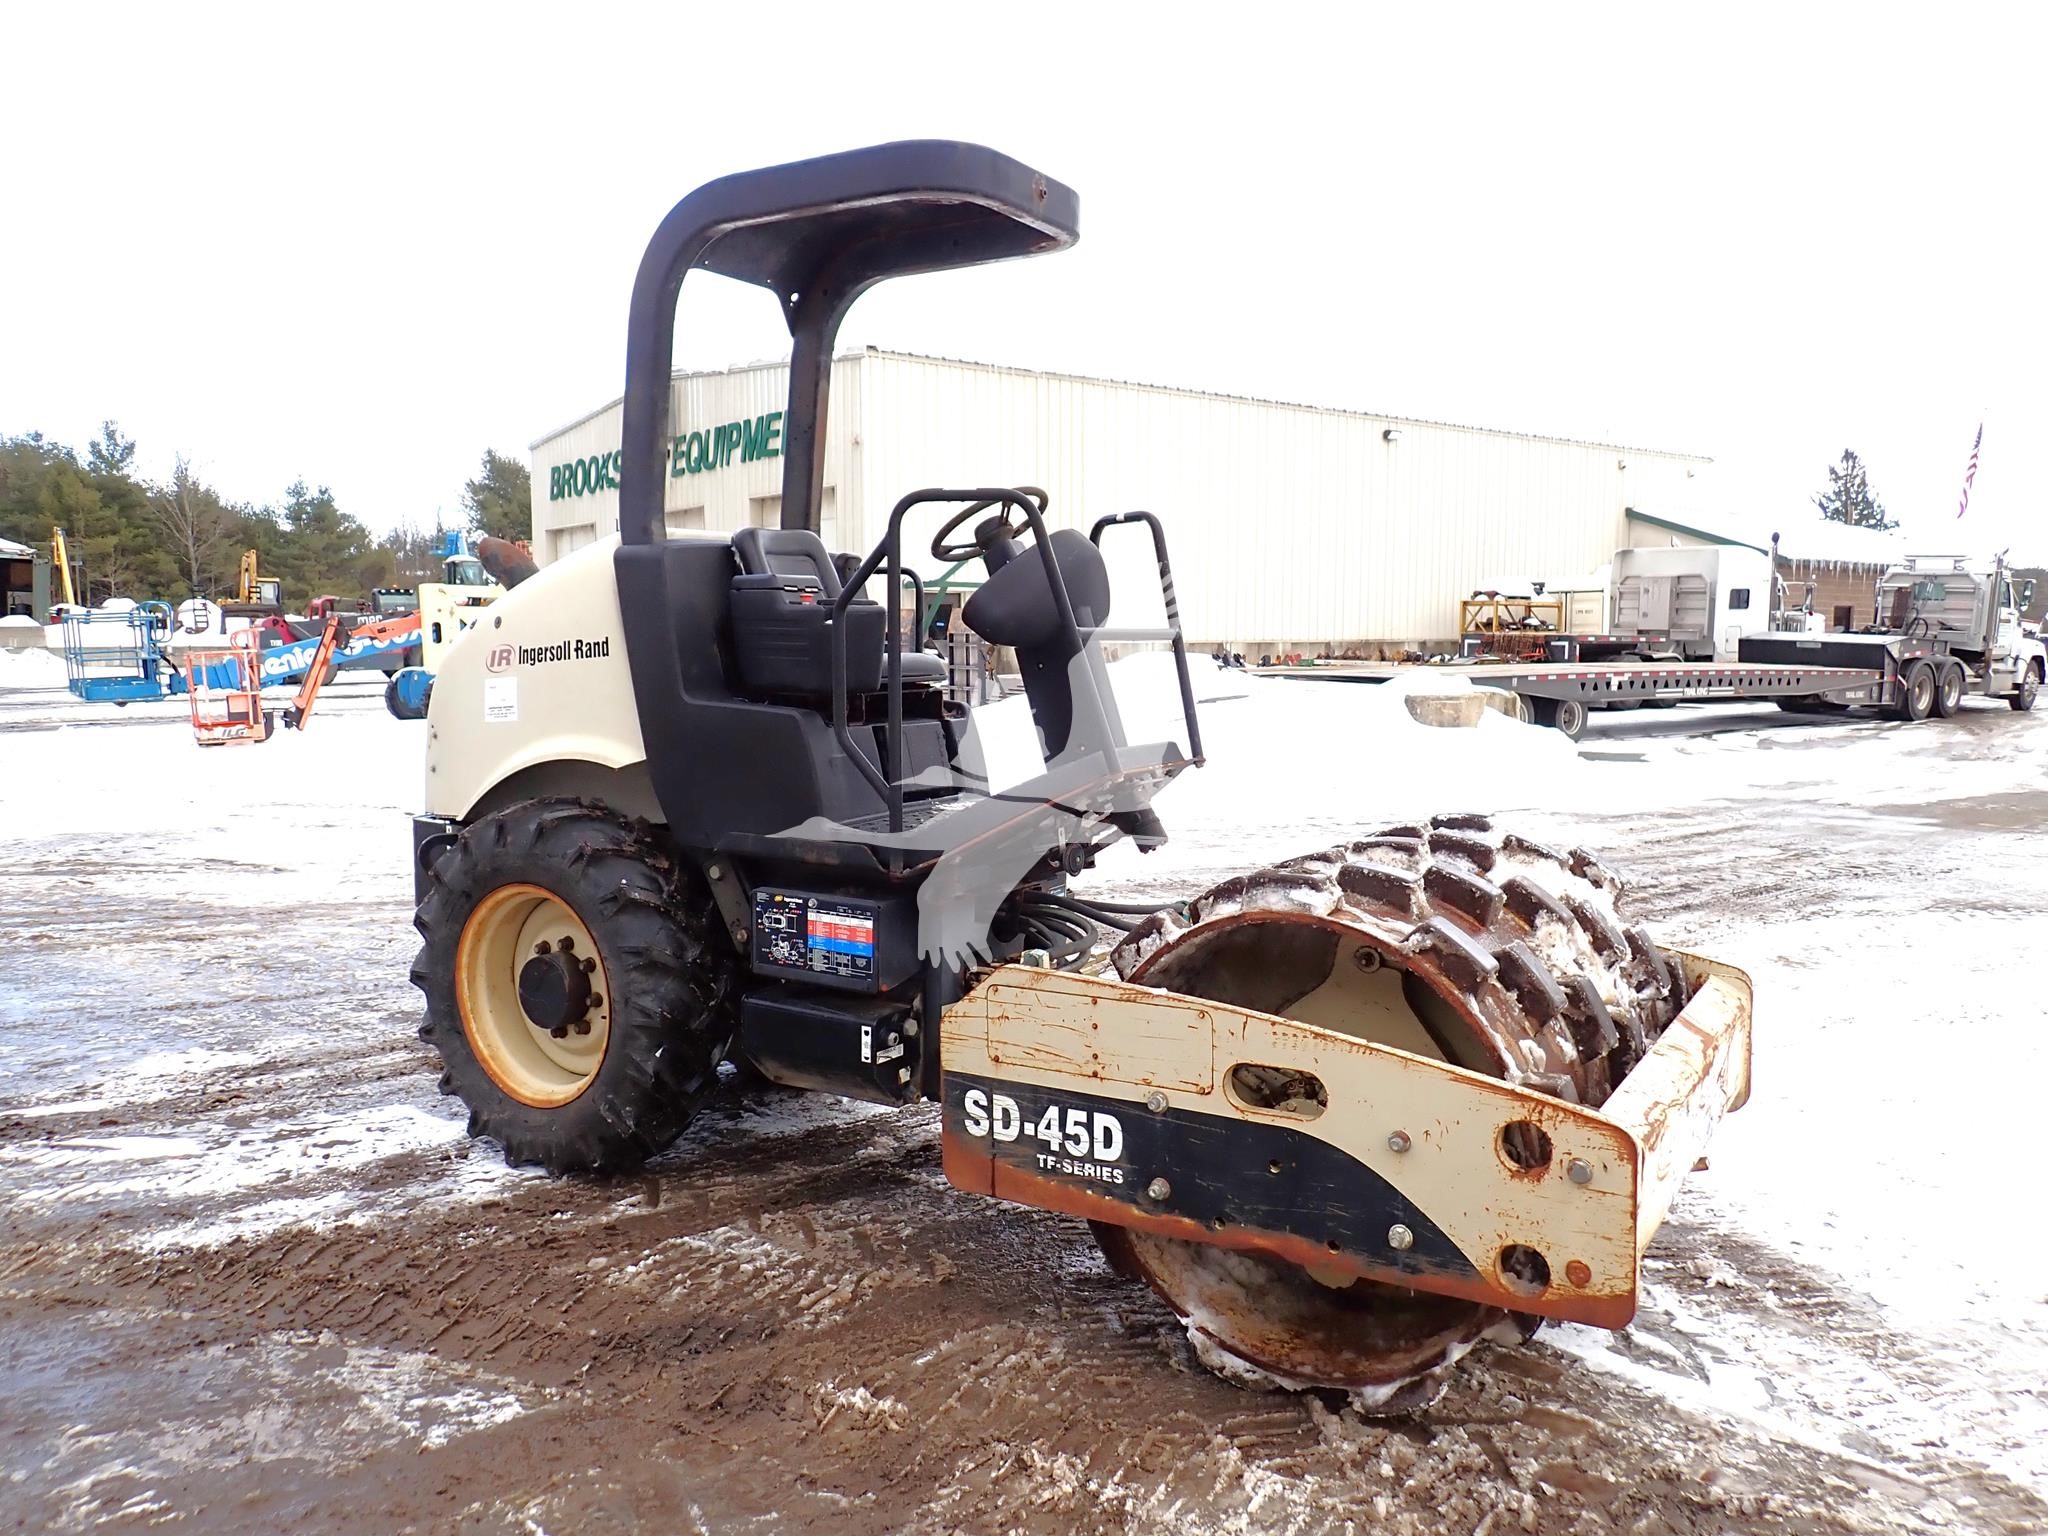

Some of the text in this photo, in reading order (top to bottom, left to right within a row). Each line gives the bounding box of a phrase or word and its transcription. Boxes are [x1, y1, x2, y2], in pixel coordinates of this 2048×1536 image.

[671, 410, 787, 478] EQUIPME
[518, 636, 610, 667] Ingersoll Rand
[963, 1089, 1124, 1163] SD-45D
[1036, 1154, 1124, 1184] TF-SERIES
